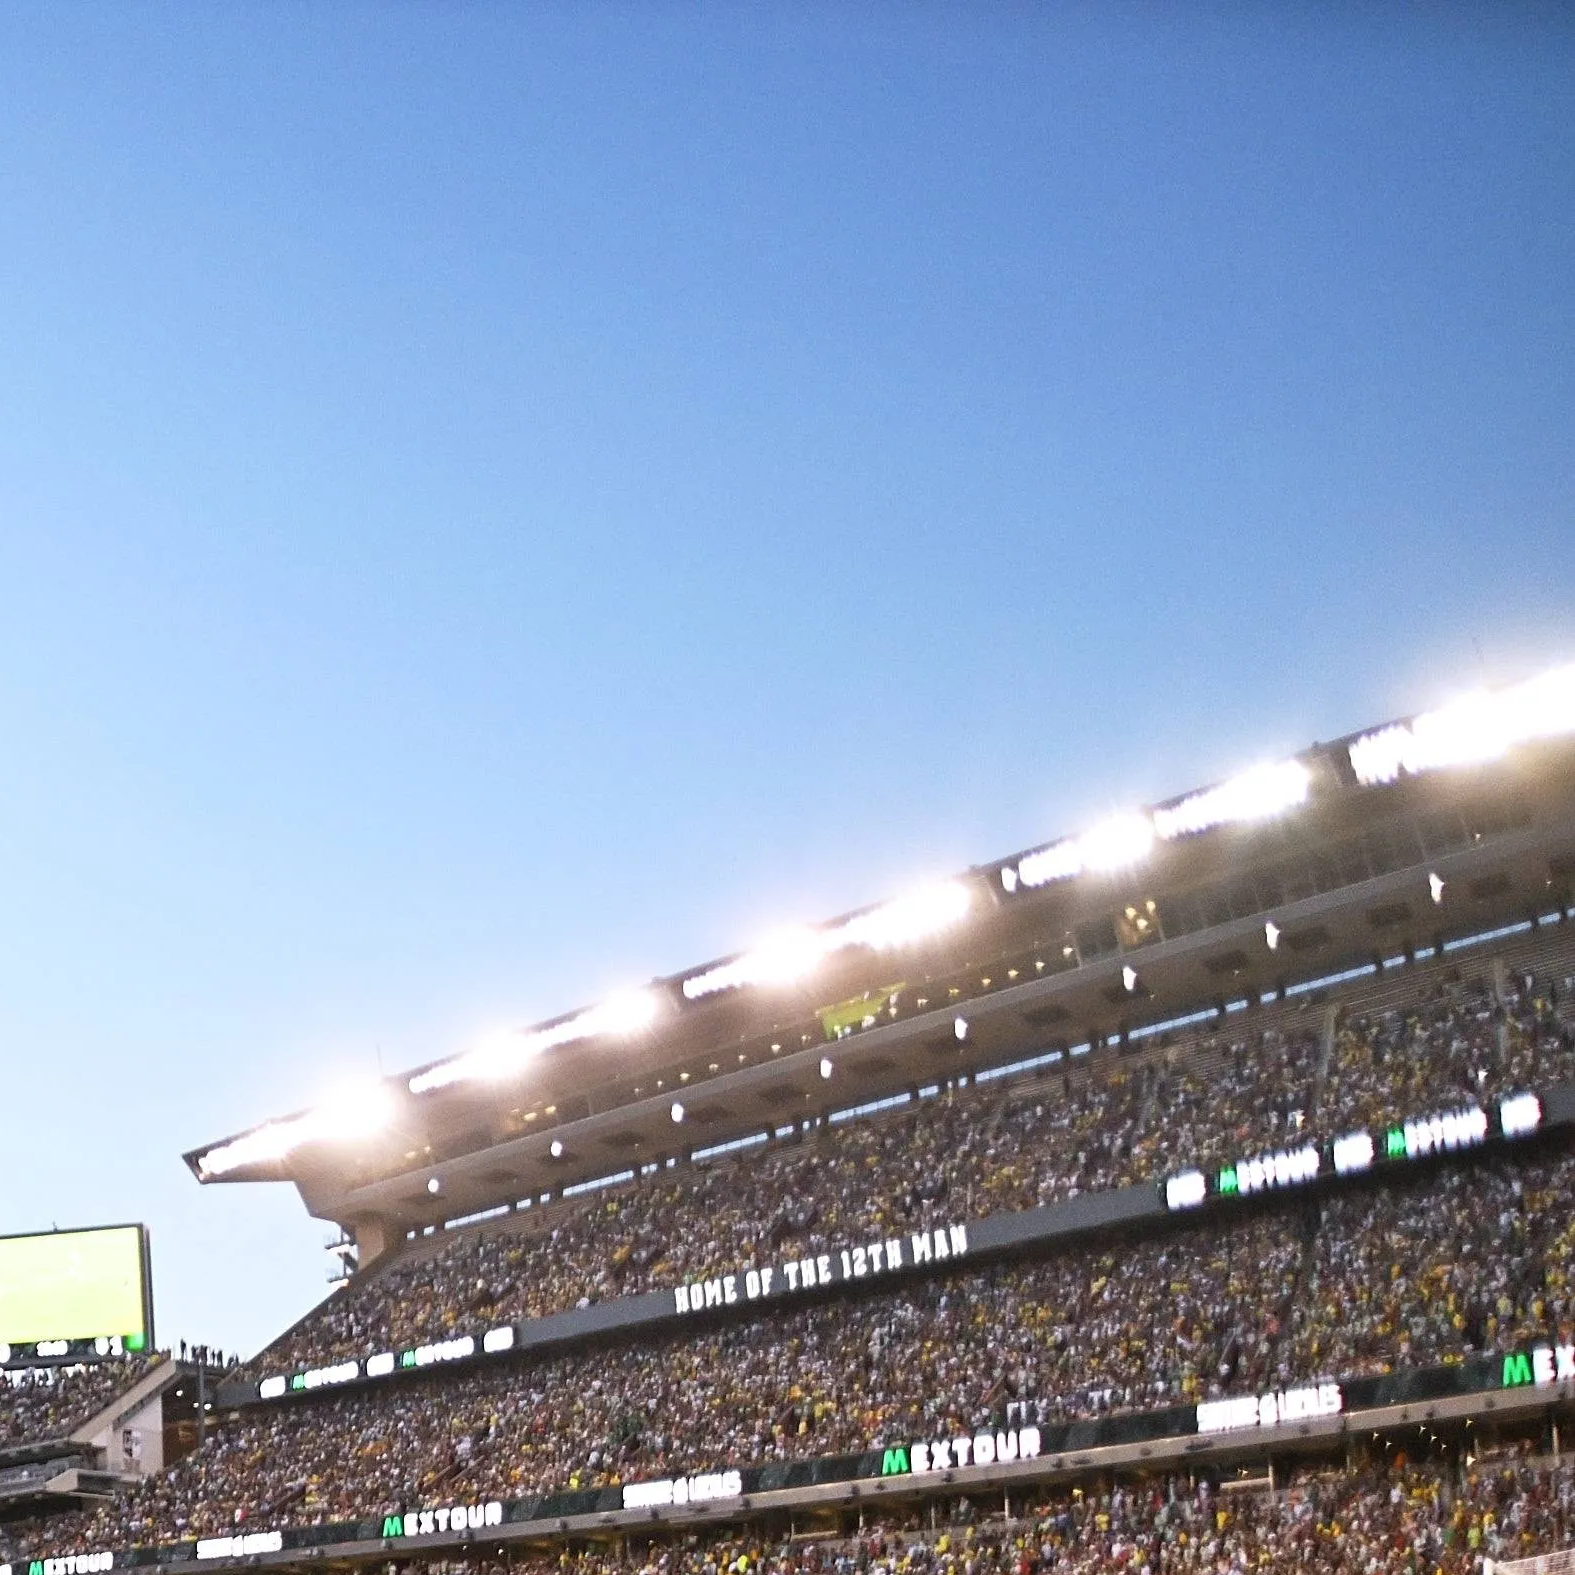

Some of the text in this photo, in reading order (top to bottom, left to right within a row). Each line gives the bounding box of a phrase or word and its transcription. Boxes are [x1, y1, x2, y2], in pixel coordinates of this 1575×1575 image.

[674, 1224, 968, 1313] HOME OF THE 12TH MAN
[882, 1427, 1041, 1476] MEXTOUR
[382, 1501, 502, 1537] MEXTOUR
